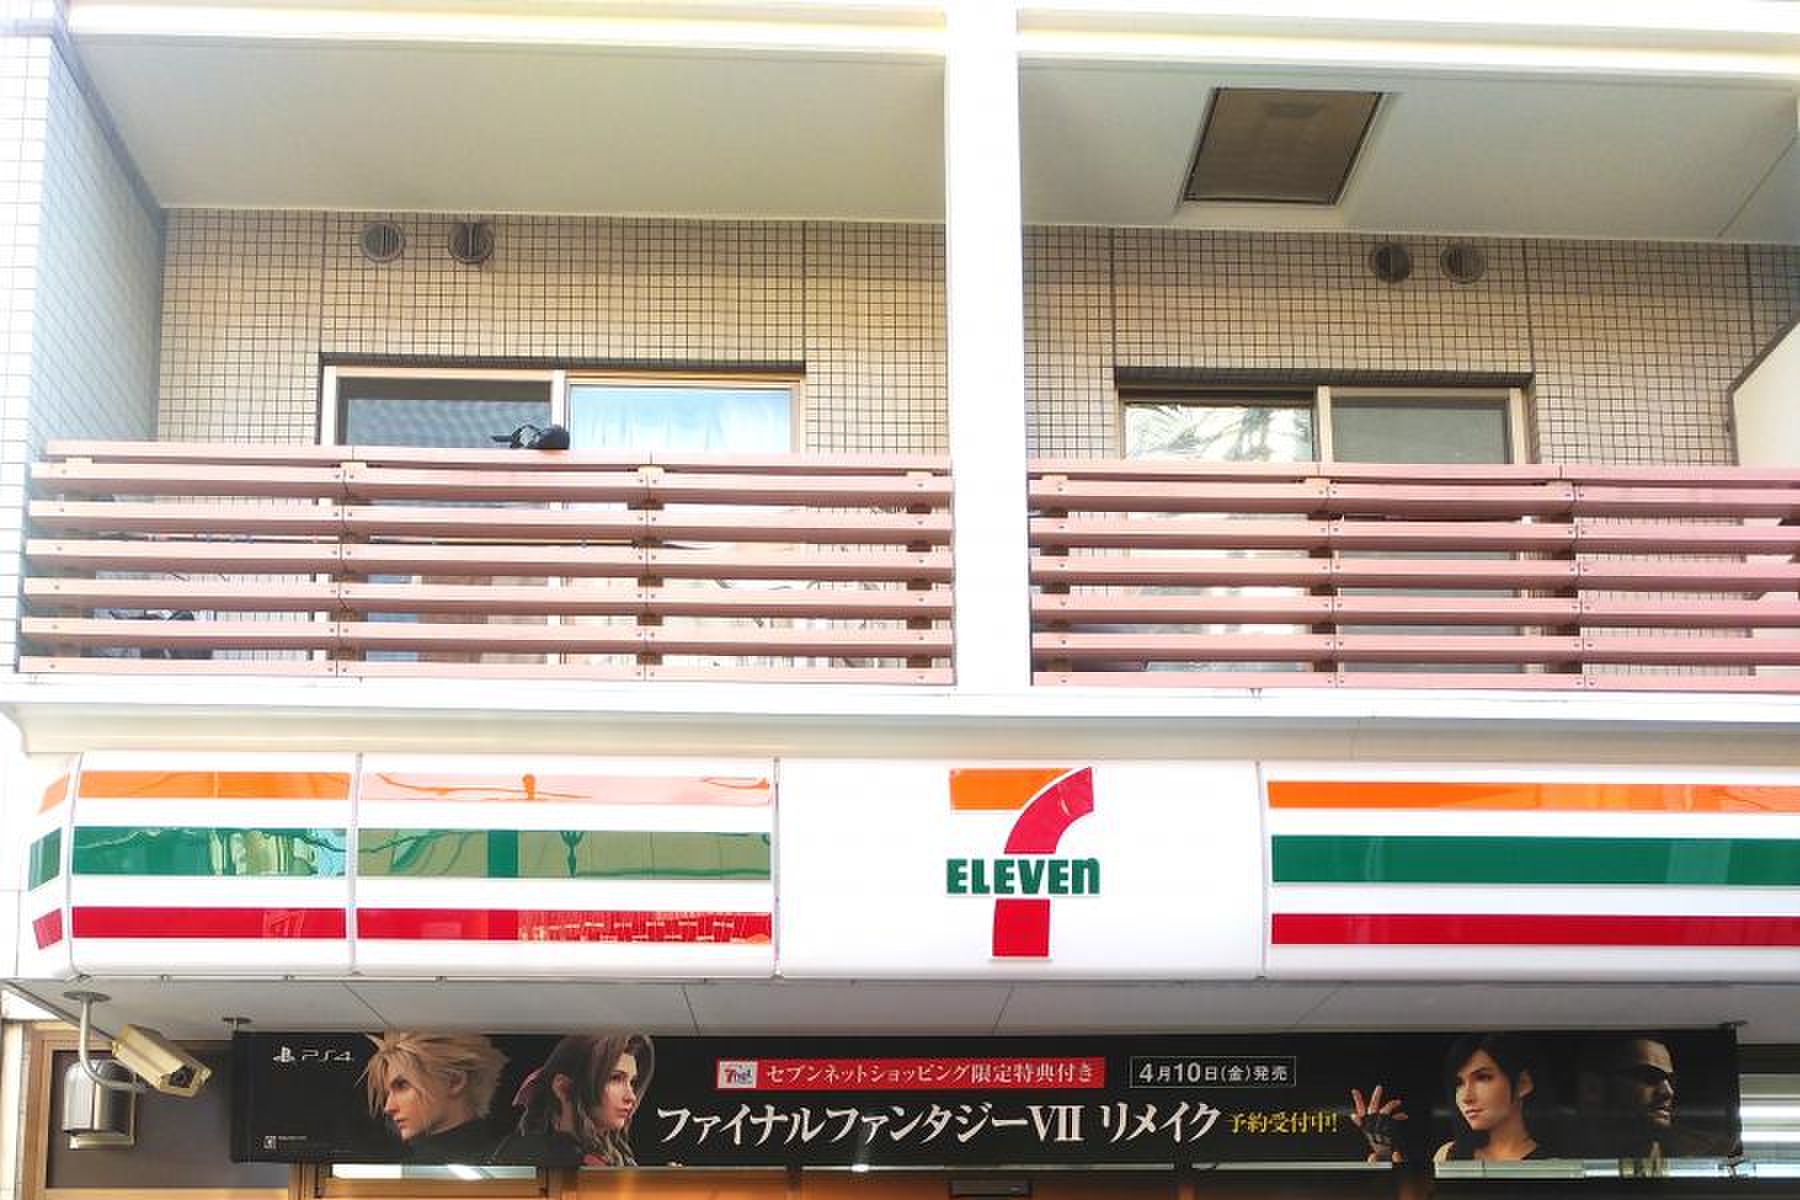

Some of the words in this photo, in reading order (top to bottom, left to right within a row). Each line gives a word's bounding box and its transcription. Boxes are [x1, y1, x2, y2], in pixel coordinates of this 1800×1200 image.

[302, 1049, 352, 1062] PS4
[766, 1062, 1094, 1085] セブンネットショッピング限定特典付き
[1101, 1101, 1222, 1145] リメイク
